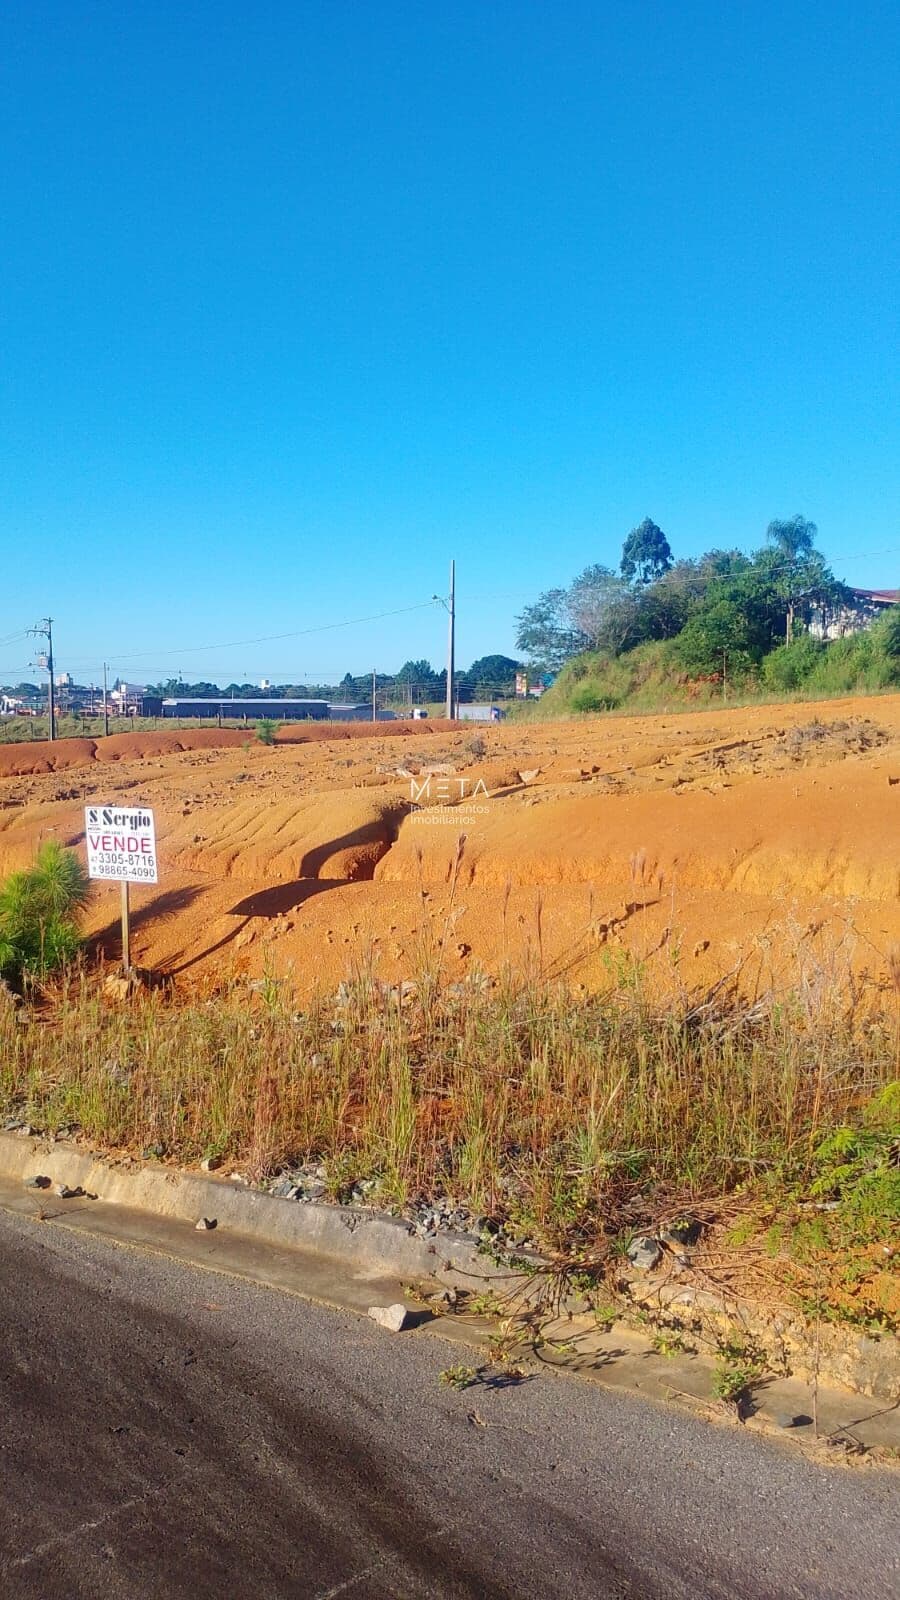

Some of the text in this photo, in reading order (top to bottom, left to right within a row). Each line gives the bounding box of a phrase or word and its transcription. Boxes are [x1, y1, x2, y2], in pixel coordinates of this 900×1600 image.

[102, 809, 151, 831] Sergio
[89, 835, 152, 853] VENDE
[98, 852, 154, 867] 3305-8716
[98, 865, 155, 878] 98865-4090
